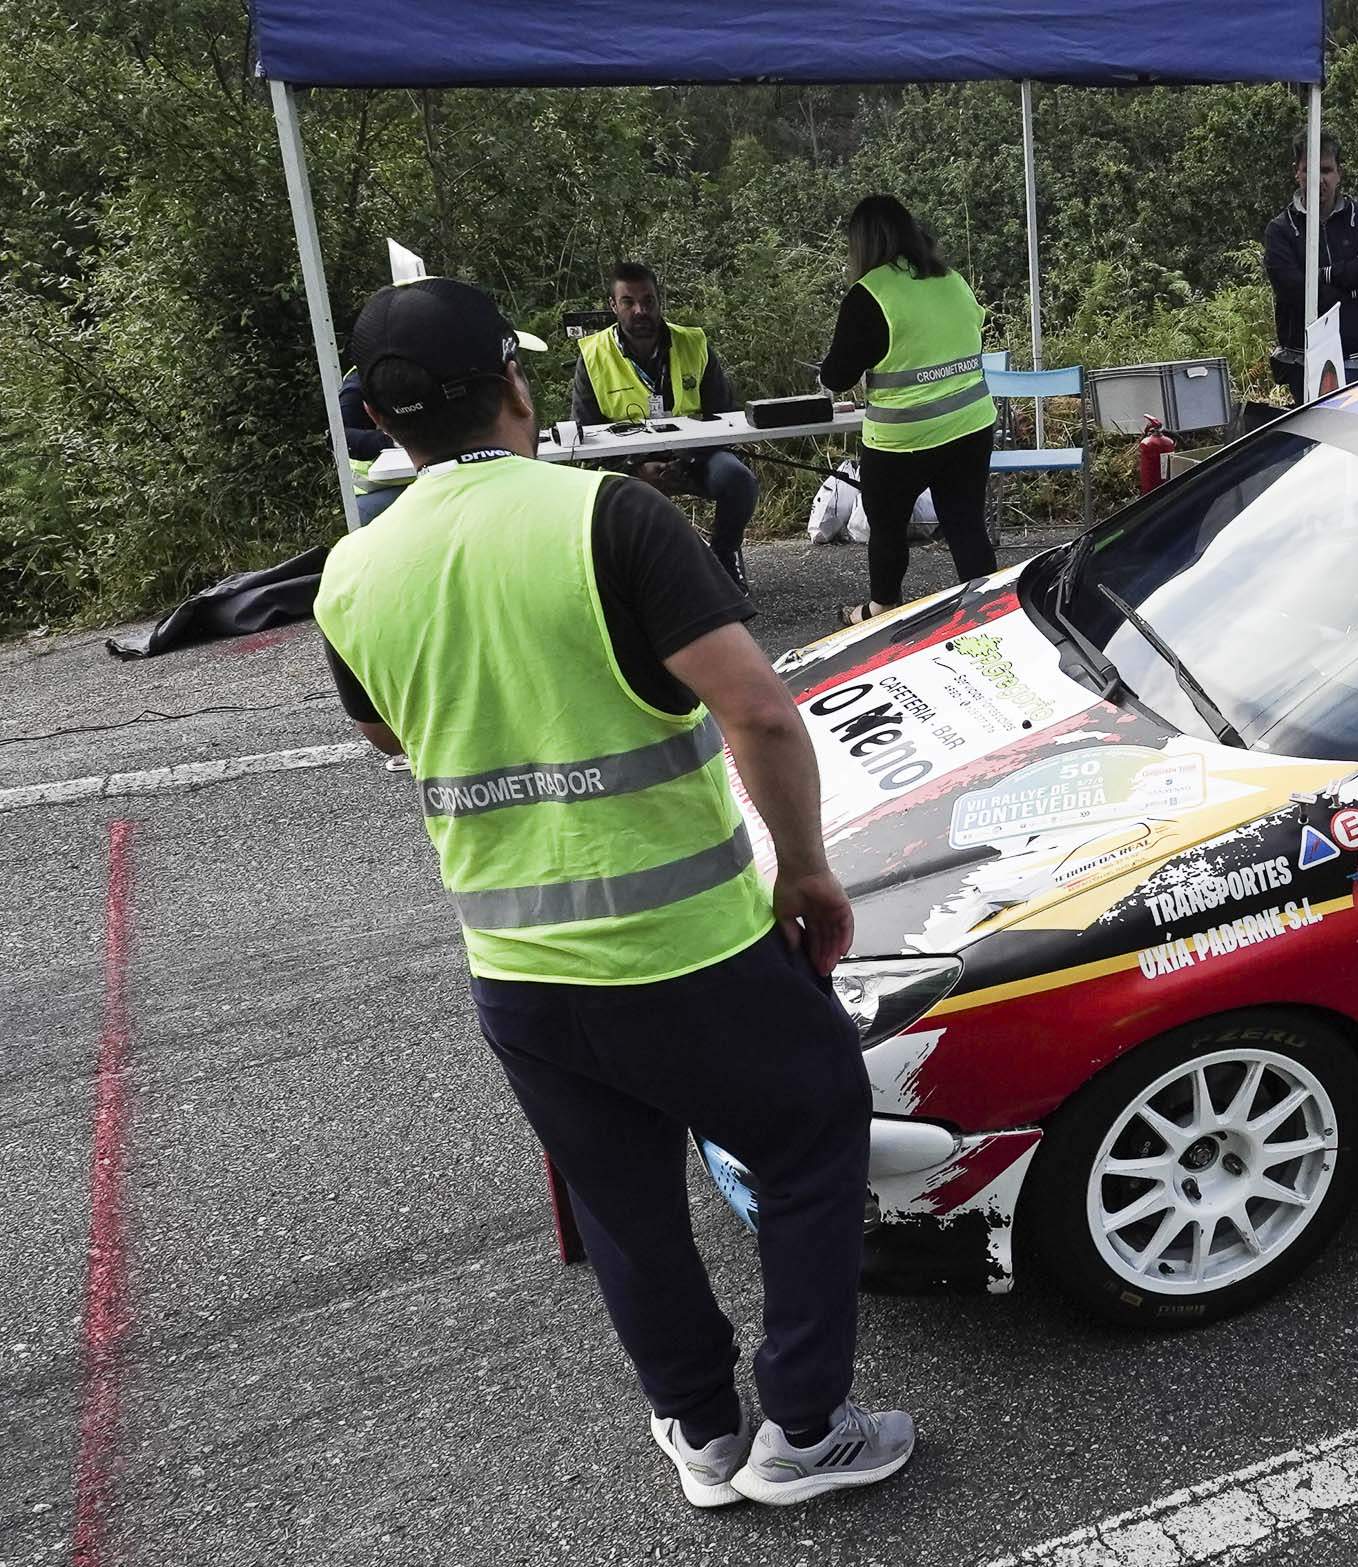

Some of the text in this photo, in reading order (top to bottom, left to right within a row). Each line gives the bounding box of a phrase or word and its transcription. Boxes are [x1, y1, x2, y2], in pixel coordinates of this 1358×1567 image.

[916, 358, 980, 383] CRONOMETRADOR
[809, 683, 874, 717] O
[931, 724, 967, 751] BAR
[1059, 760, 1102, 779] 50
[427, 767, 605, 811] CRONOMETRADOR
[966, 798, 987, 813] VII
[991, 787, 1047, 809] RALLYE
[1050, 782, 1070, 796] DE
[962, 788, 1108, 830] PONTEVEDRA
[1145, 855, 1294, 927] TRANSPORTES
[1137, 932, 1195, 980] UXÍA
[1192, 912, 1288, 963] PADERNE
[1283, 897, 1324, 931] S.L.
